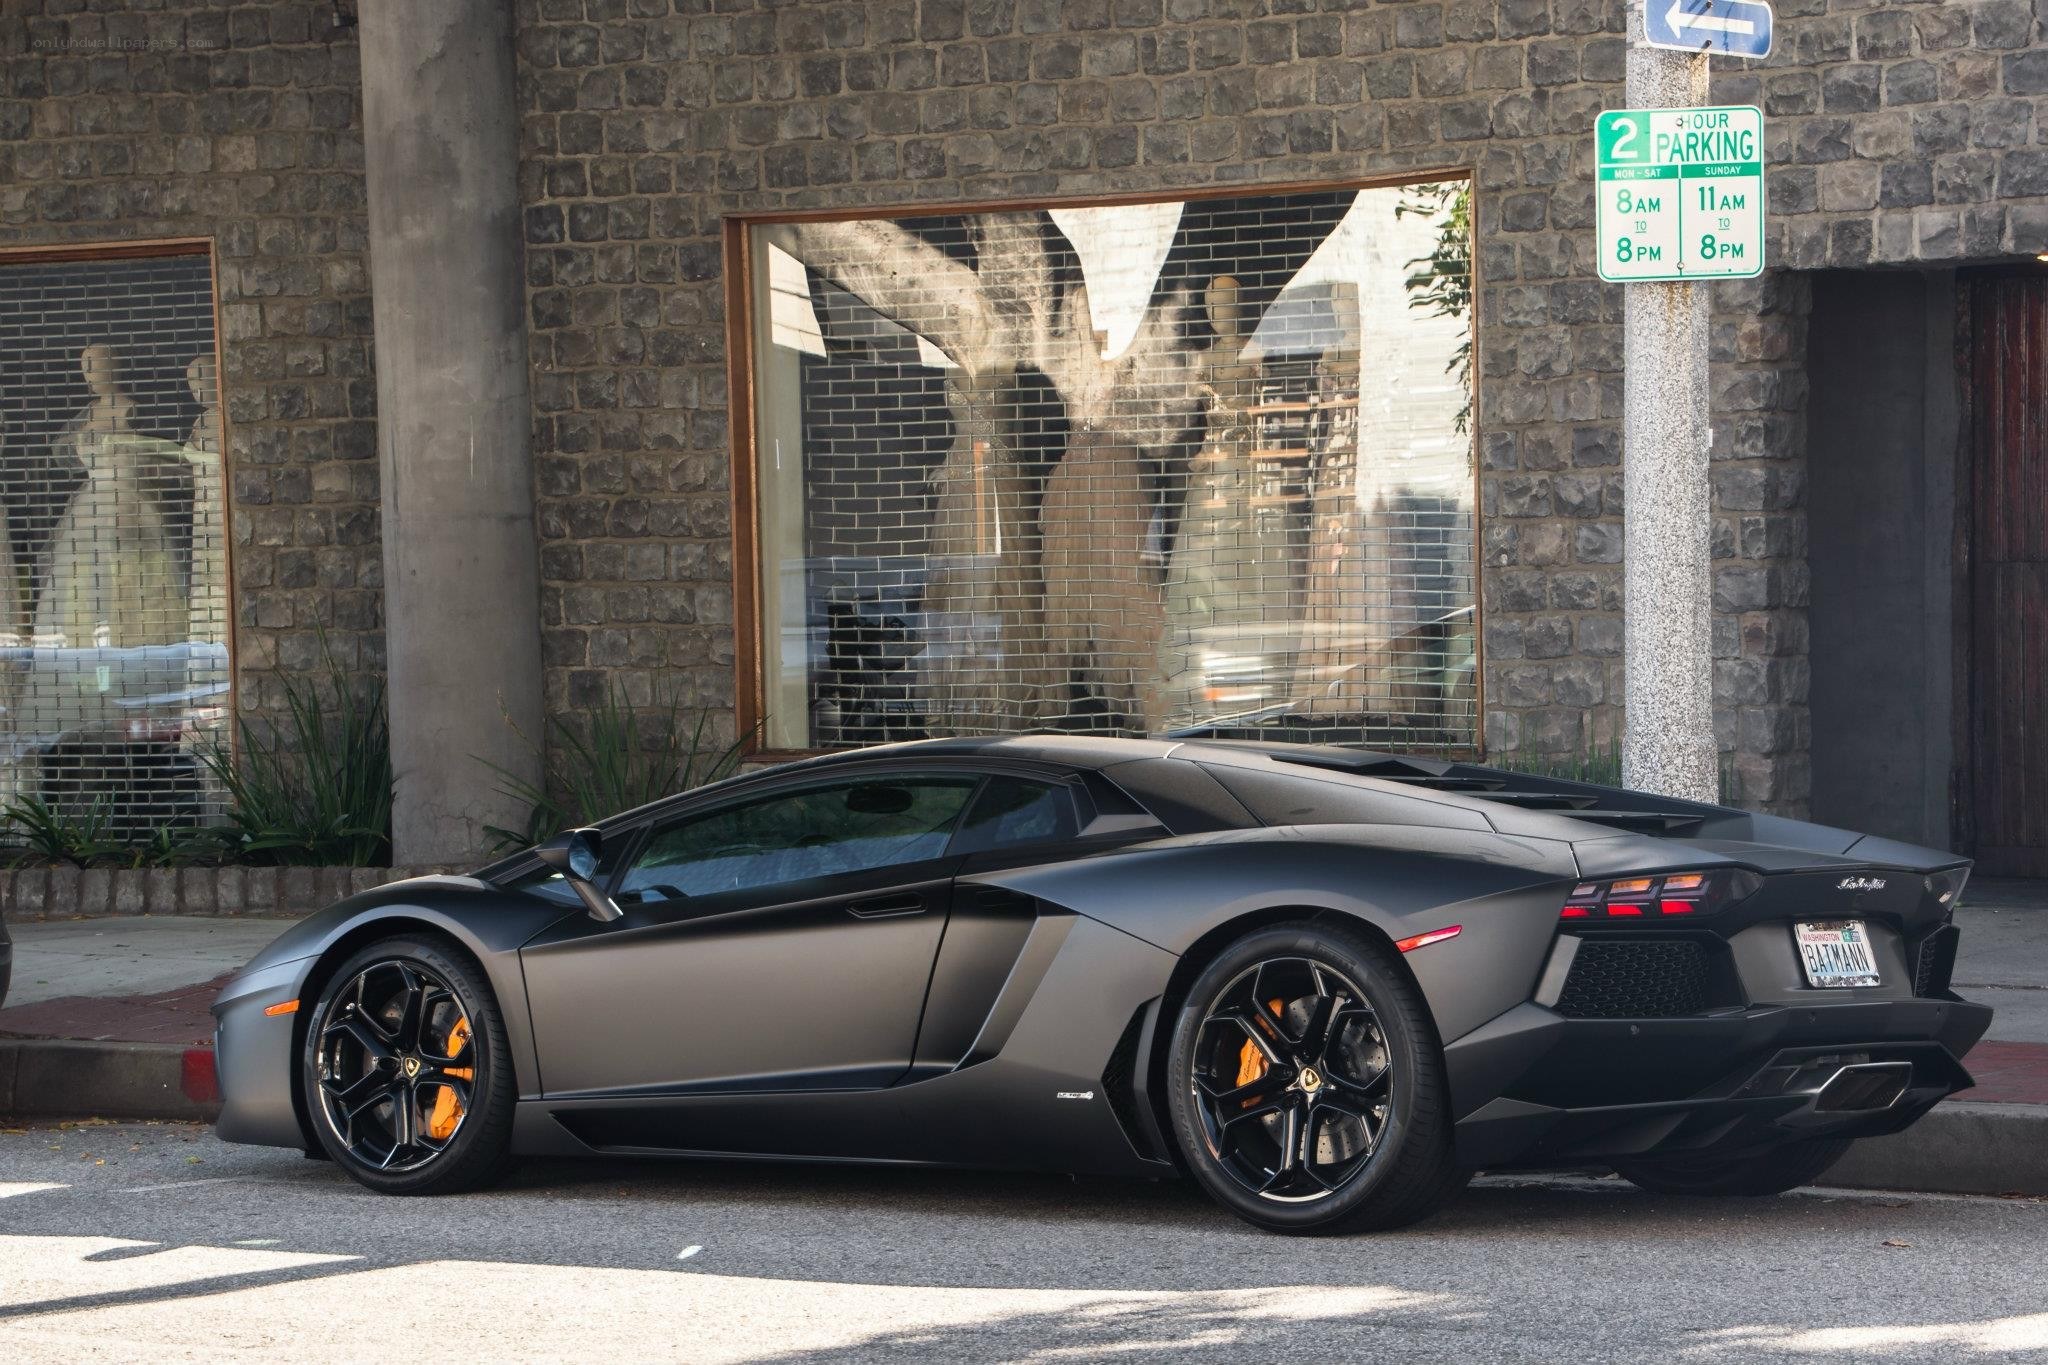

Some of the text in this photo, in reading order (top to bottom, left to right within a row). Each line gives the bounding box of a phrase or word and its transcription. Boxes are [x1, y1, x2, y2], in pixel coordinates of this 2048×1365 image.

[1680, 113, 1729, 130] HOUR
[1610, 117, 1639, 160] 2
[1656, 130, 1753, 163] PARKING
[1705, 166, 1742, 176] SUNDAY
[1635, 221, 1647, 231] TO
[1718, 218, 1731, 228] TO
[1802, 932, 1840, 942] WASHINGTON
[1804, 943, 1871, 973] BATMANN
